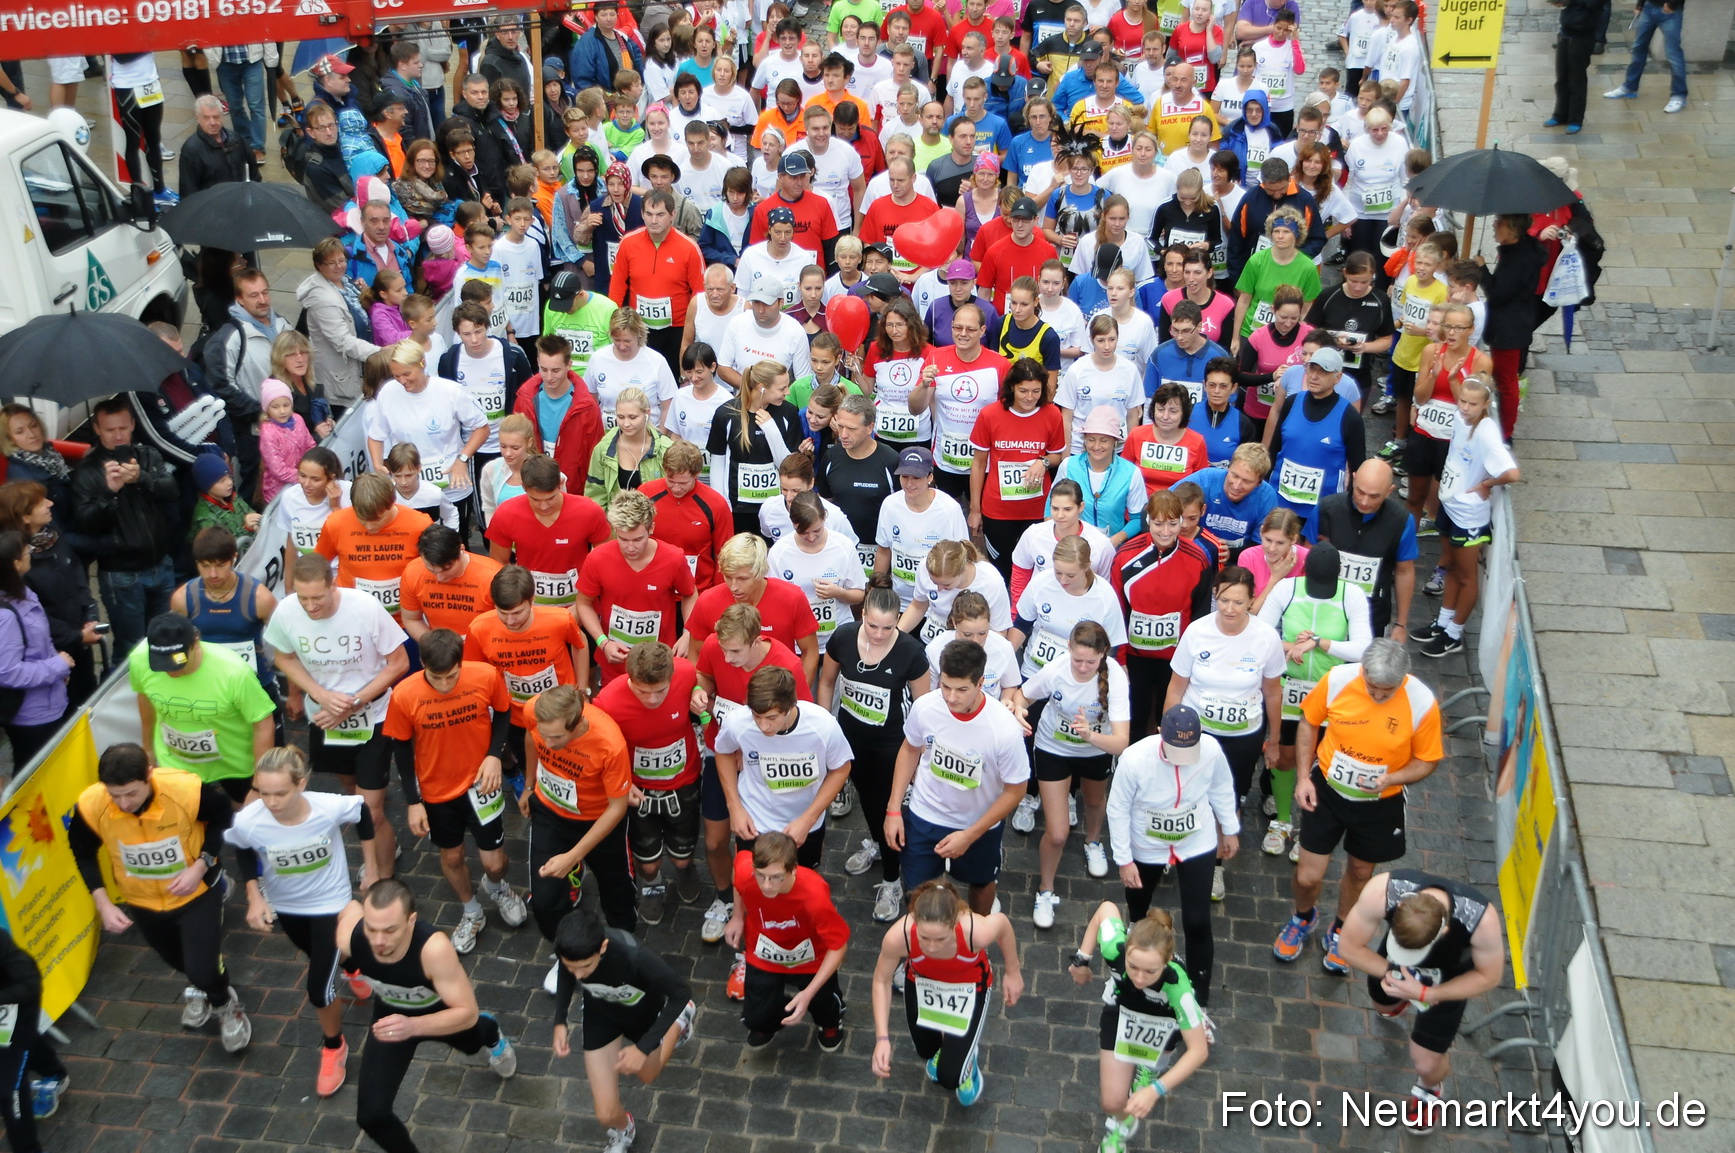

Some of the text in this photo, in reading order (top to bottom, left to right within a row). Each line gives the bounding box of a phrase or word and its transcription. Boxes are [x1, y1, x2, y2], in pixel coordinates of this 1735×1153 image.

[137, 0, 210, 24] 09181
[1441, 0, 1502, 15] Jugend-
[1455, 16, 1485, 31] lauf
[1366, 190, 1392, 204] 5178
[508, 289, 533, 303] 4043
[639, 304, 667, 318] 5151
[882, 416, 915, 431] 5120
[1422, 408, 1454, 428] 4062
[995, 441, 1040, 450] NEUMARKT
[1147, 444, 1183, 462] 5079
[949, 457, 969, 466] Andreas
[1152, 463, 1172, 471] Christa
[743, 472, 777, 488] 5092
[1282, 471, 1316, 492] 5174
[374, 543, 404, 552] LAUFEN
[348, 553, 403, 562] NICHT DAVON
[364, 588, 401, 605] 089
[537, 581, 573, 596] 5161
[429, 592, 475, 603] WIR LAUFEN
[422, 601, 474, 612] NICHT DAVON
[614, 616, 654, 635] 5158
[1134, 621, 1175, 637] 5103
[299, 635, 331, 654] BC
[497, 648, 547, 660] WIR LAUFEN
[493, 657, 546, 669] NICHT DAVON
[510, 677, 553, 693] 5086
[844, 686, 884, 709] 5003
[427, 703, 477, 721] WIR LAUFEN
[853, 703, 870, 716] Tanja
[1204, 704, 1248, 723] 5188
[422, 714, 477, 731] NICHT DAVON
[168, 732, 211, 752] 5026
[538, 742, 584, 772] WIR LAUFEN
[640, 749, 683, 769] 5153
[1338, 743, 1383, 763] WERNER
[554, 761, 580, 779] DAVON
[766, 762, 814, 778] 5006
[933, 749, 976, 778] 5007
[778, 780, 804, 788] Florian
[940, 770, 964, 784] Tobias
[1151, 813, 1195, 832] 5050
[125, 848, 178, 866] 5099
[276, 846, 329, 867] 5190
[761, 946, 809, 962] 5057
[924, 989, 969, 1014] 5147
[1124, 1020, 1167, 1048] 5705
